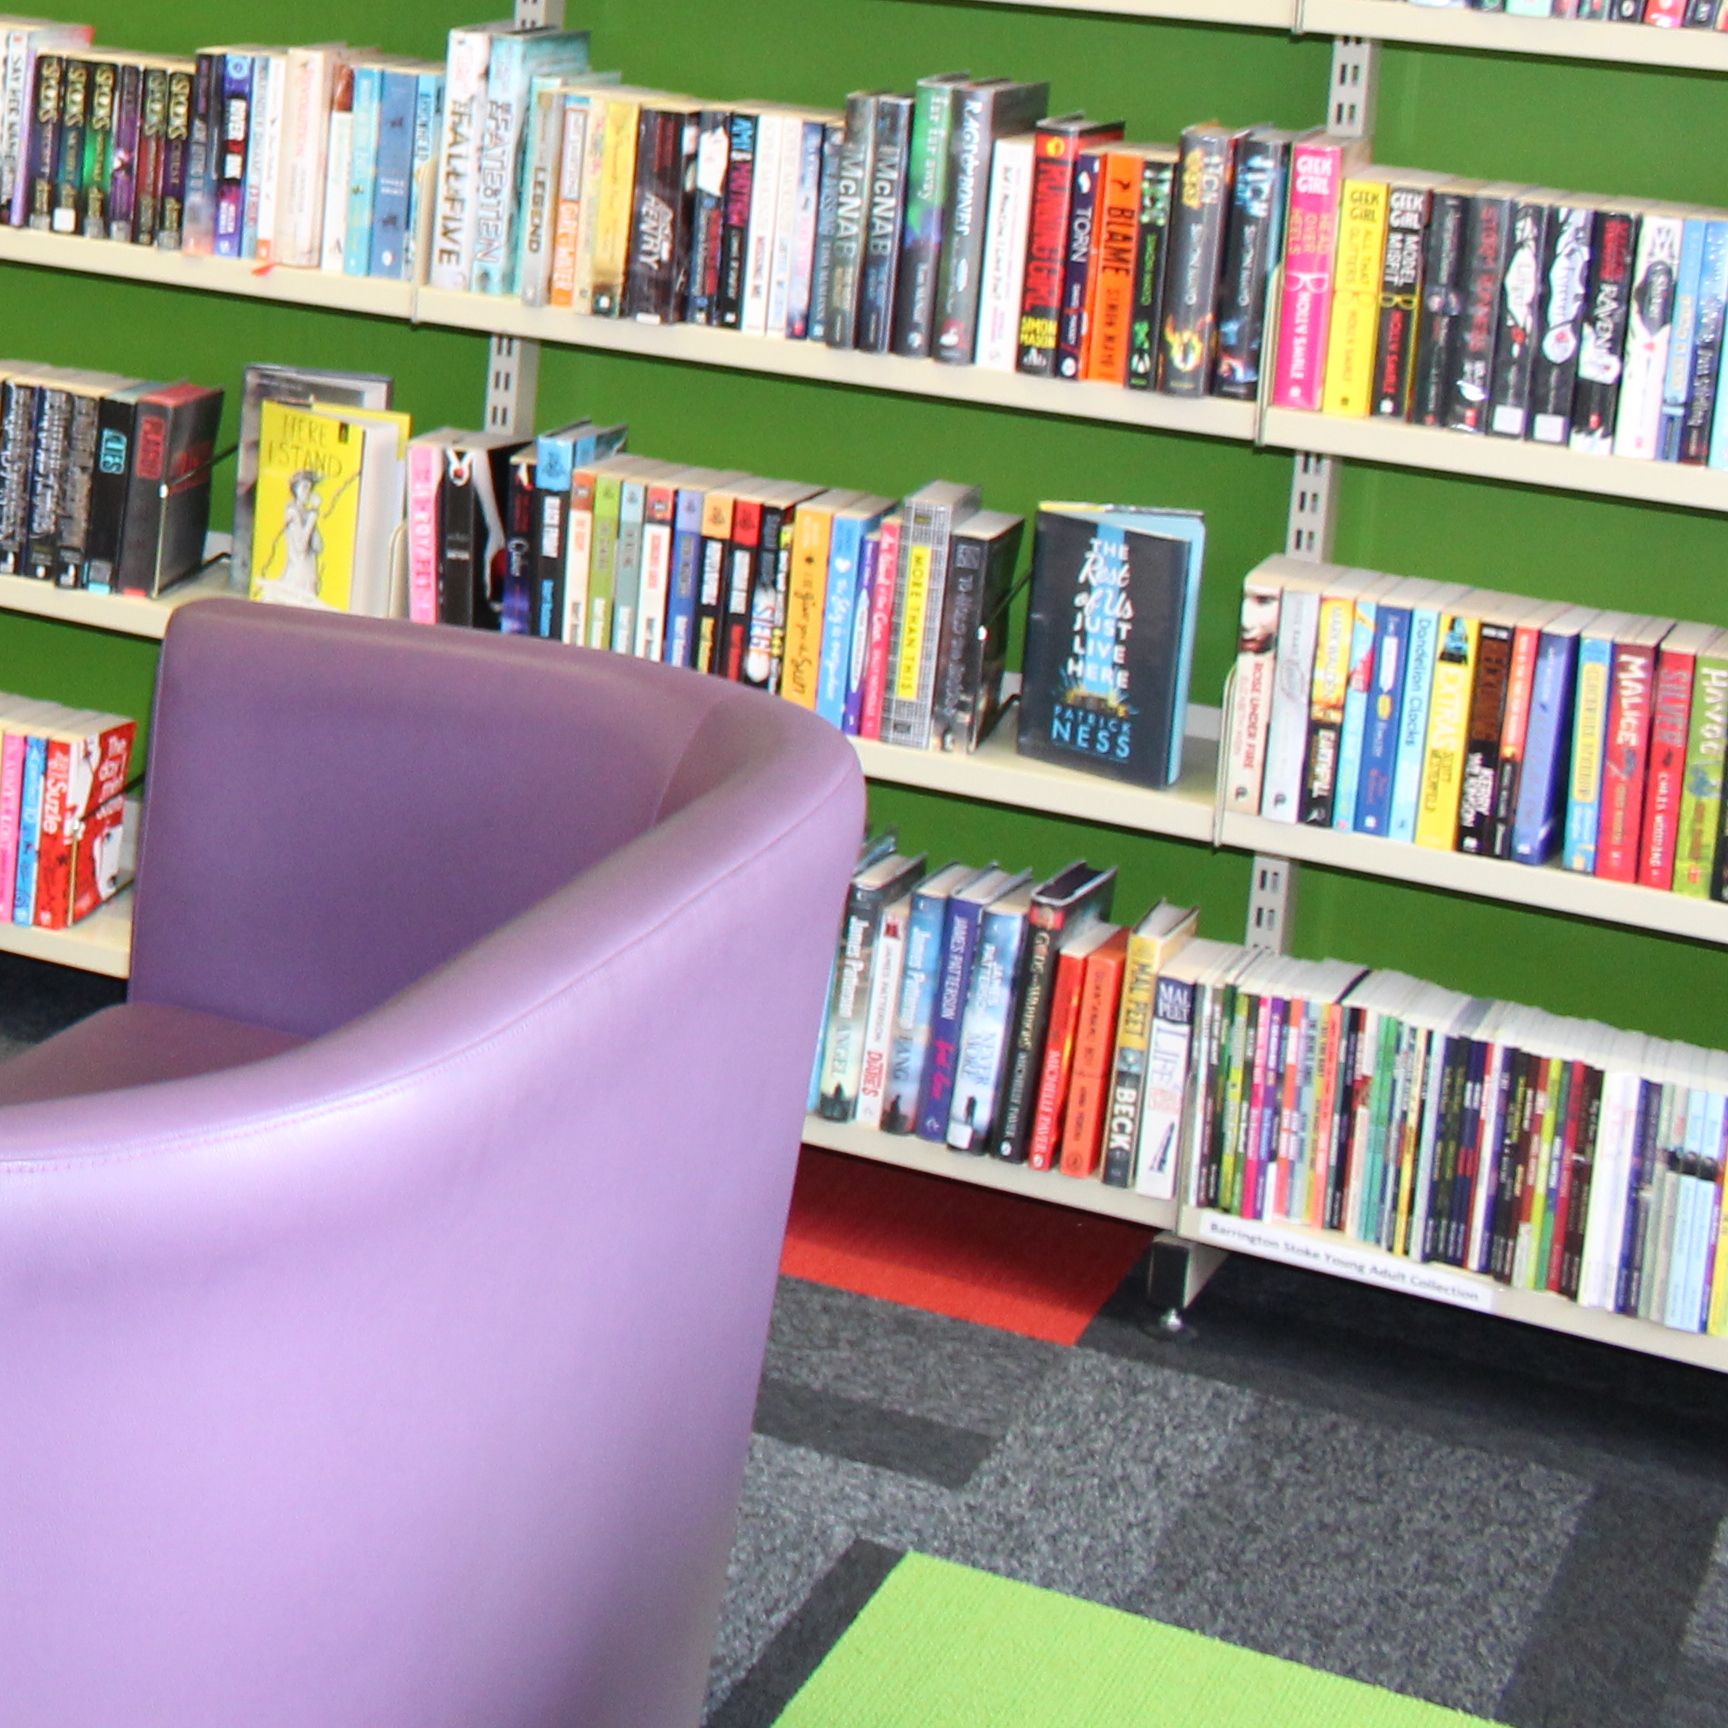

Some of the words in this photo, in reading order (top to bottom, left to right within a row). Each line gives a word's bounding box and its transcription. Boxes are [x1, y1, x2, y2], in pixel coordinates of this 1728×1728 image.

[961, 99, 983, 153] RAGS
[918, 159, 940, 202] away
[527, 166, 547, 253] LEGEND
[835, 158, 867, 257] McNAB
[869, 158, 900, 256] McNAB
[1032, 163, 1074, 258] RUNNING
[438, 195, 466, 266] FIVE
[474, 200, 503, 263] TEN
[638, 192, 666, 270] HENRY
[1071, 208, 1093, 263] TORN
[1102, 206, 1133, 277] BLAME
[1383, 232, 1403, 285] MISFIT
[1399, 234, 1417, 286] MODEL
[1024, 260, 1063, 311] GIRL
[1293, 292, 1313, 333] HOLLY
[1288, 336, 1308, 379] SMALE
[279, 414, 328, 445] HERE
[277, 444, 344, 478] STAND
[1090, 537, 1130, 561] THE
[909, 555, 925, 597] MORE
[1079, 554, 1131, 588] Rest
[904, 607, 920, 647] THAN
[1073, 634, 1125, 663] LIVE
[1074, 617, 1132, 639] JUST
[900, 656, 915, 691] THIS
[1068, 657, 1130, 691] HERE
[1410, 618, 1433, 692] Dandelion
[1249, 662, 1264, 692] ROSE
[1053, 704, 1132, 736] PATRICK
[1245, 696, 1262, 737] UNDER
[1404, 696, 1425, 746] Clocks
[1430, 666, 1464, 752] EXTRAS
[1616, 654, 1648, 746] MALICE
[1655, 668, 1687, 745] SILVER
[1052, 720, 1131, 759] NESS
[1243, 741, 1258, 768] FIRE
[41, 778, 66, 833] Suzie
[1654, 772, 1670, 810] CHRIS
[848, 916, 869, 955] James
[910, 926, 931, 967] James
[950, 916, 968, 953] JAMES
[837, 958, 865, 1018] Patterson
[940, 954, 964, 1020] PATTERSON
[1131, 962, 1149, 997] MAL
[1124, 1000, 1147, 1037] PEET
[1110, 1086, 1136, 1152] BECK
[1210, 1222, 1280, 1251] Barrington
[1283, 1242, 1321, 1260] Stoke
[1324, 1252, 1366, 1275] Young
[1369, 1263, 1408, 1284] Adult
[1411, 1273, 1480, 1301] Collection
